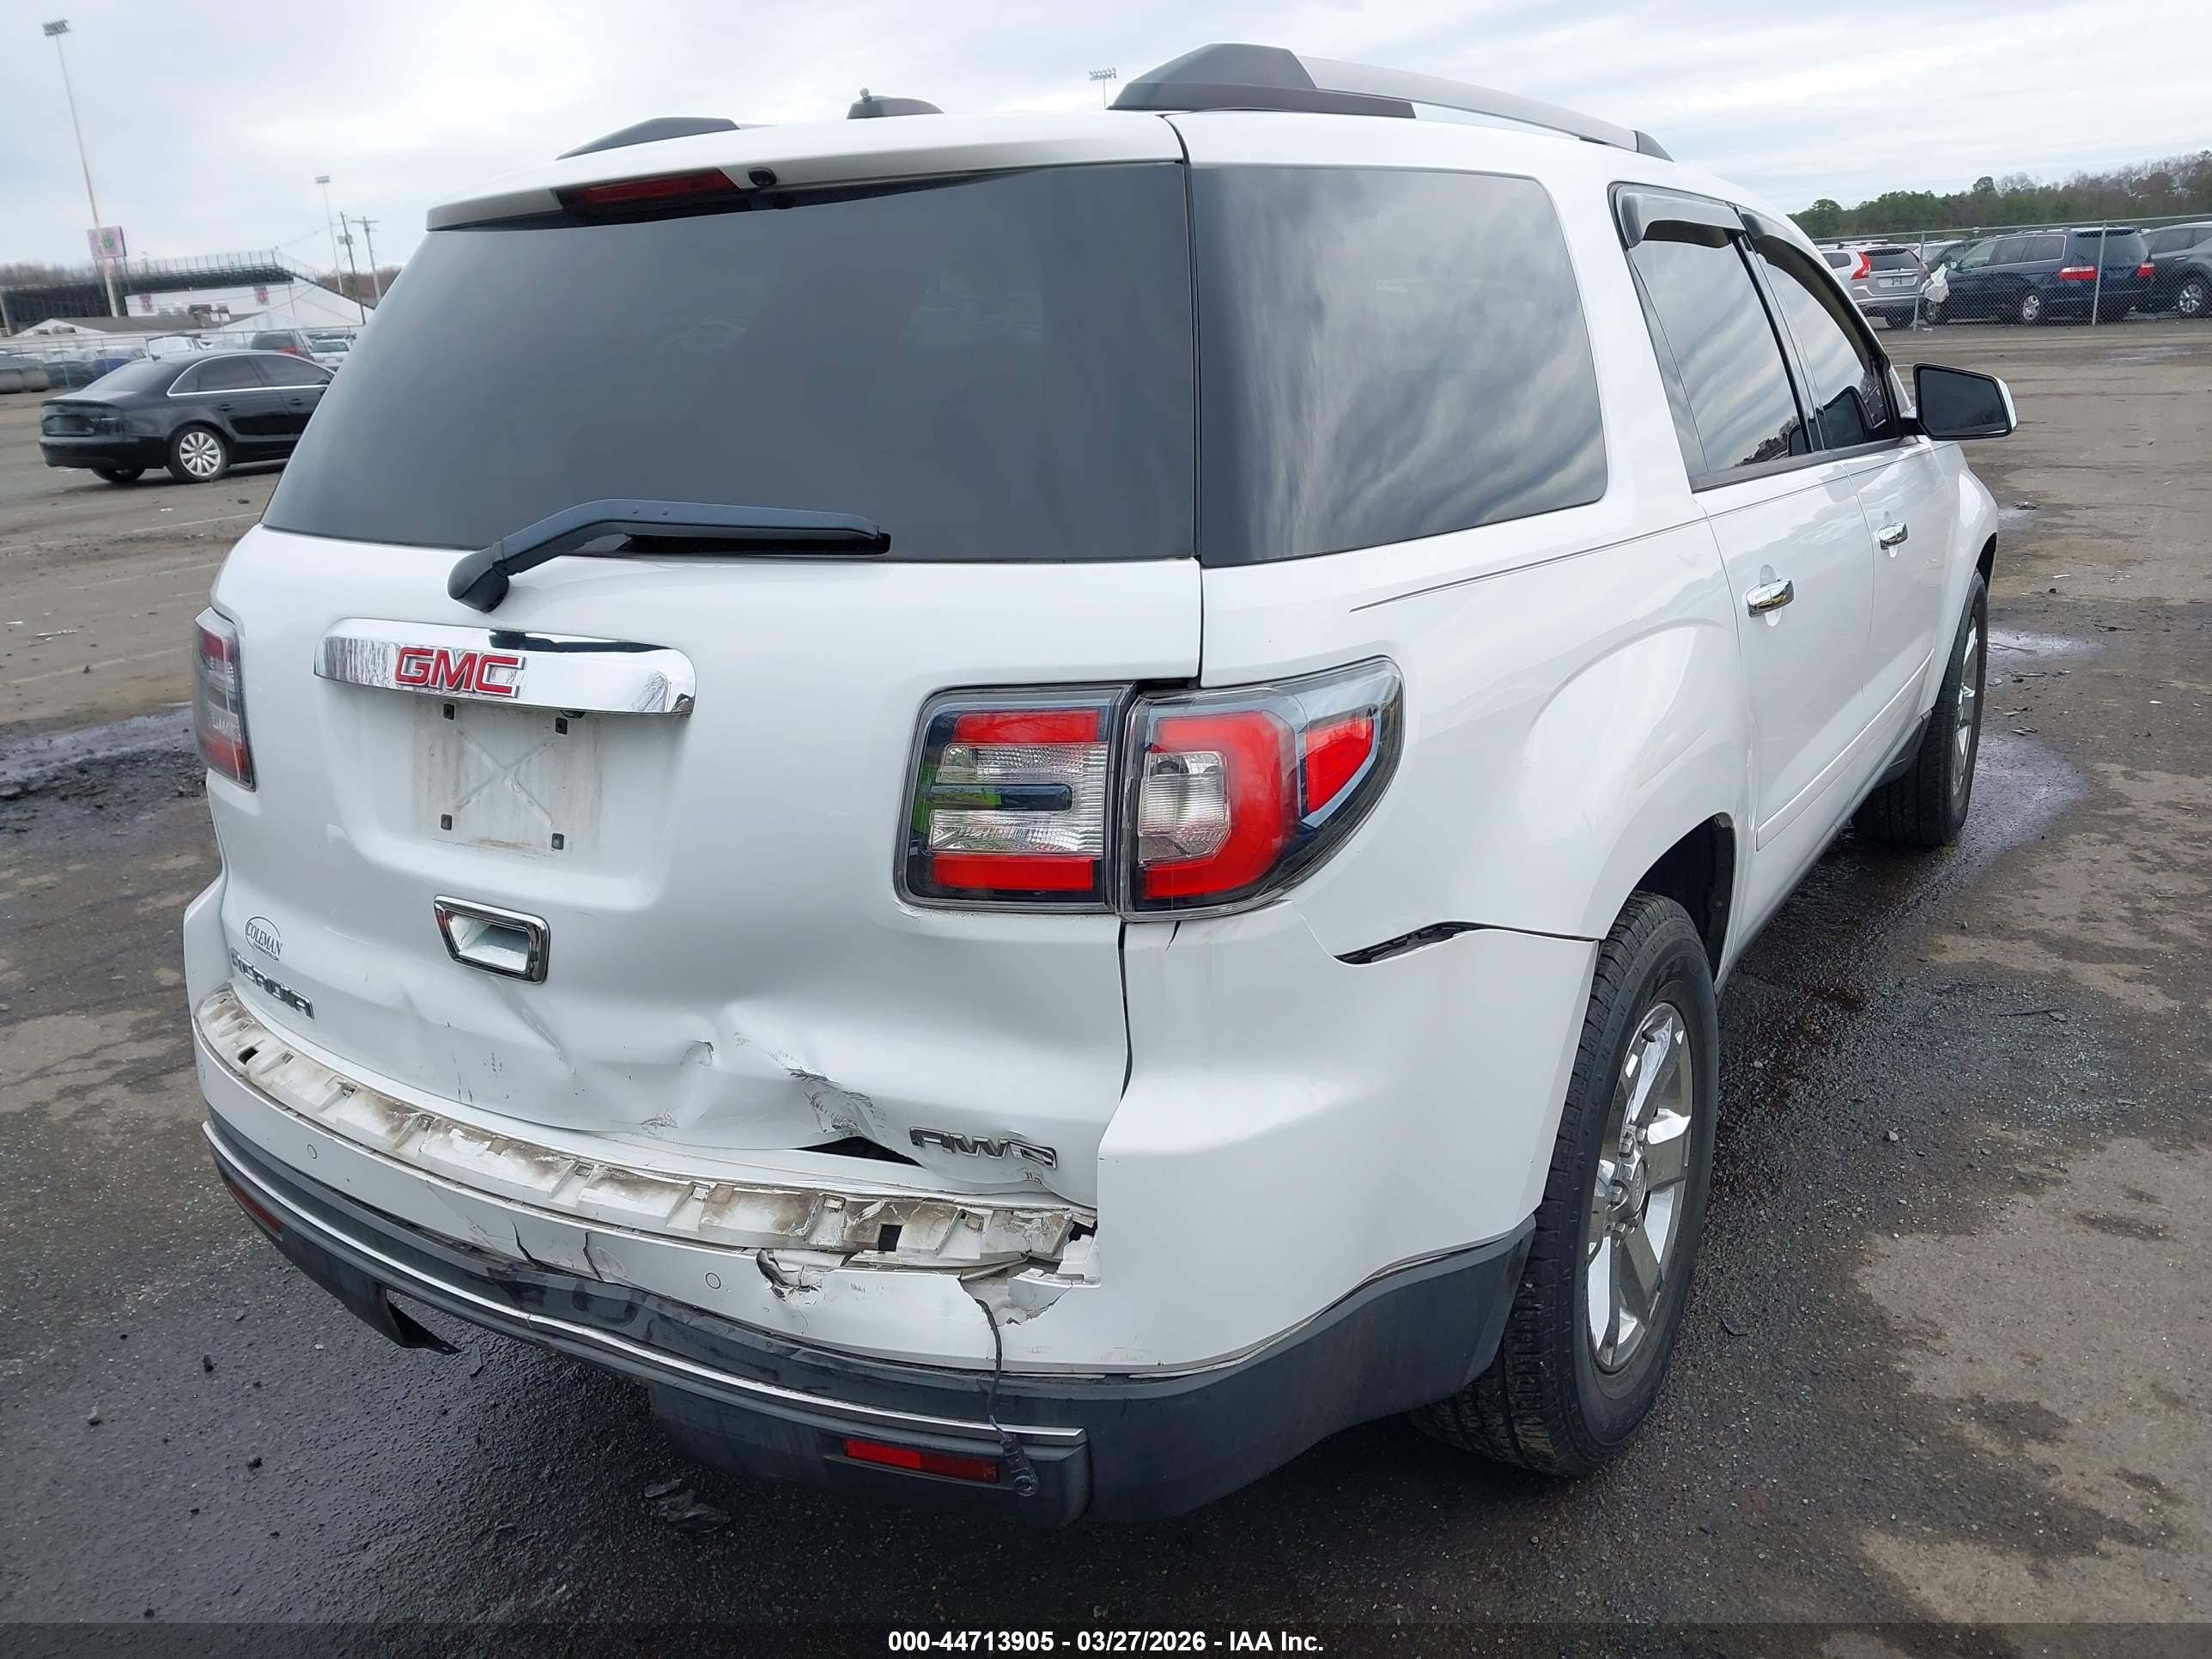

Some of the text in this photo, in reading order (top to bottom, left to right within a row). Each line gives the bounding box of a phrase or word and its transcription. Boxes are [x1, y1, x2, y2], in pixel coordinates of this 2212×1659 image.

[395, 647, 525, 698] GMC
[246, 922, 283, 956] COLEMAN
[909, 1127, 1057, 1169] AWD
